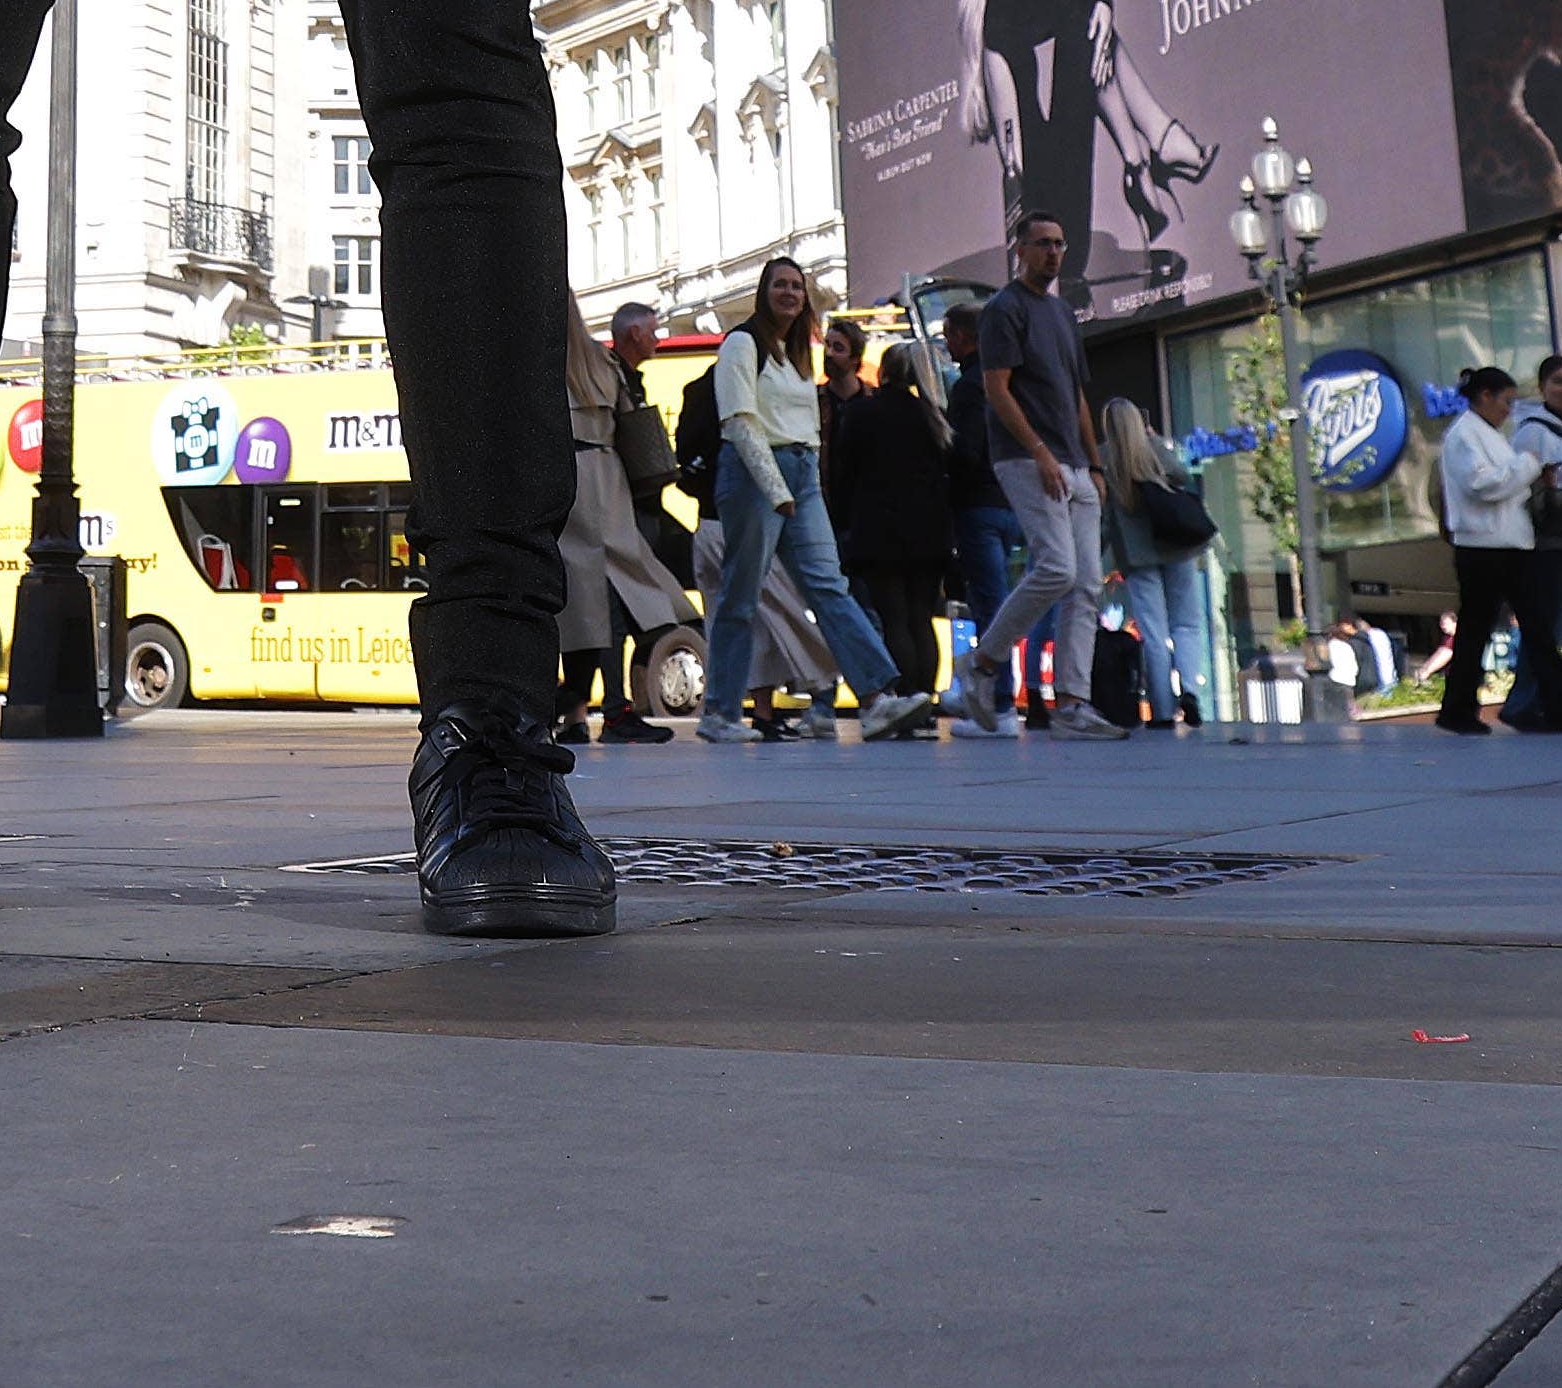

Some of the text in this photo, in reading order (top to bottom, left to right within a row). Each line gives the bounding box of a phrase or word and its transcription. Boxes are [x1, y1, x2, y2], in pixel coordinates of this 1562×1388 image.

[251, 626, 293, 663] find
[298, 637, 324, 664] us
[330, 628, 352, 664] in
